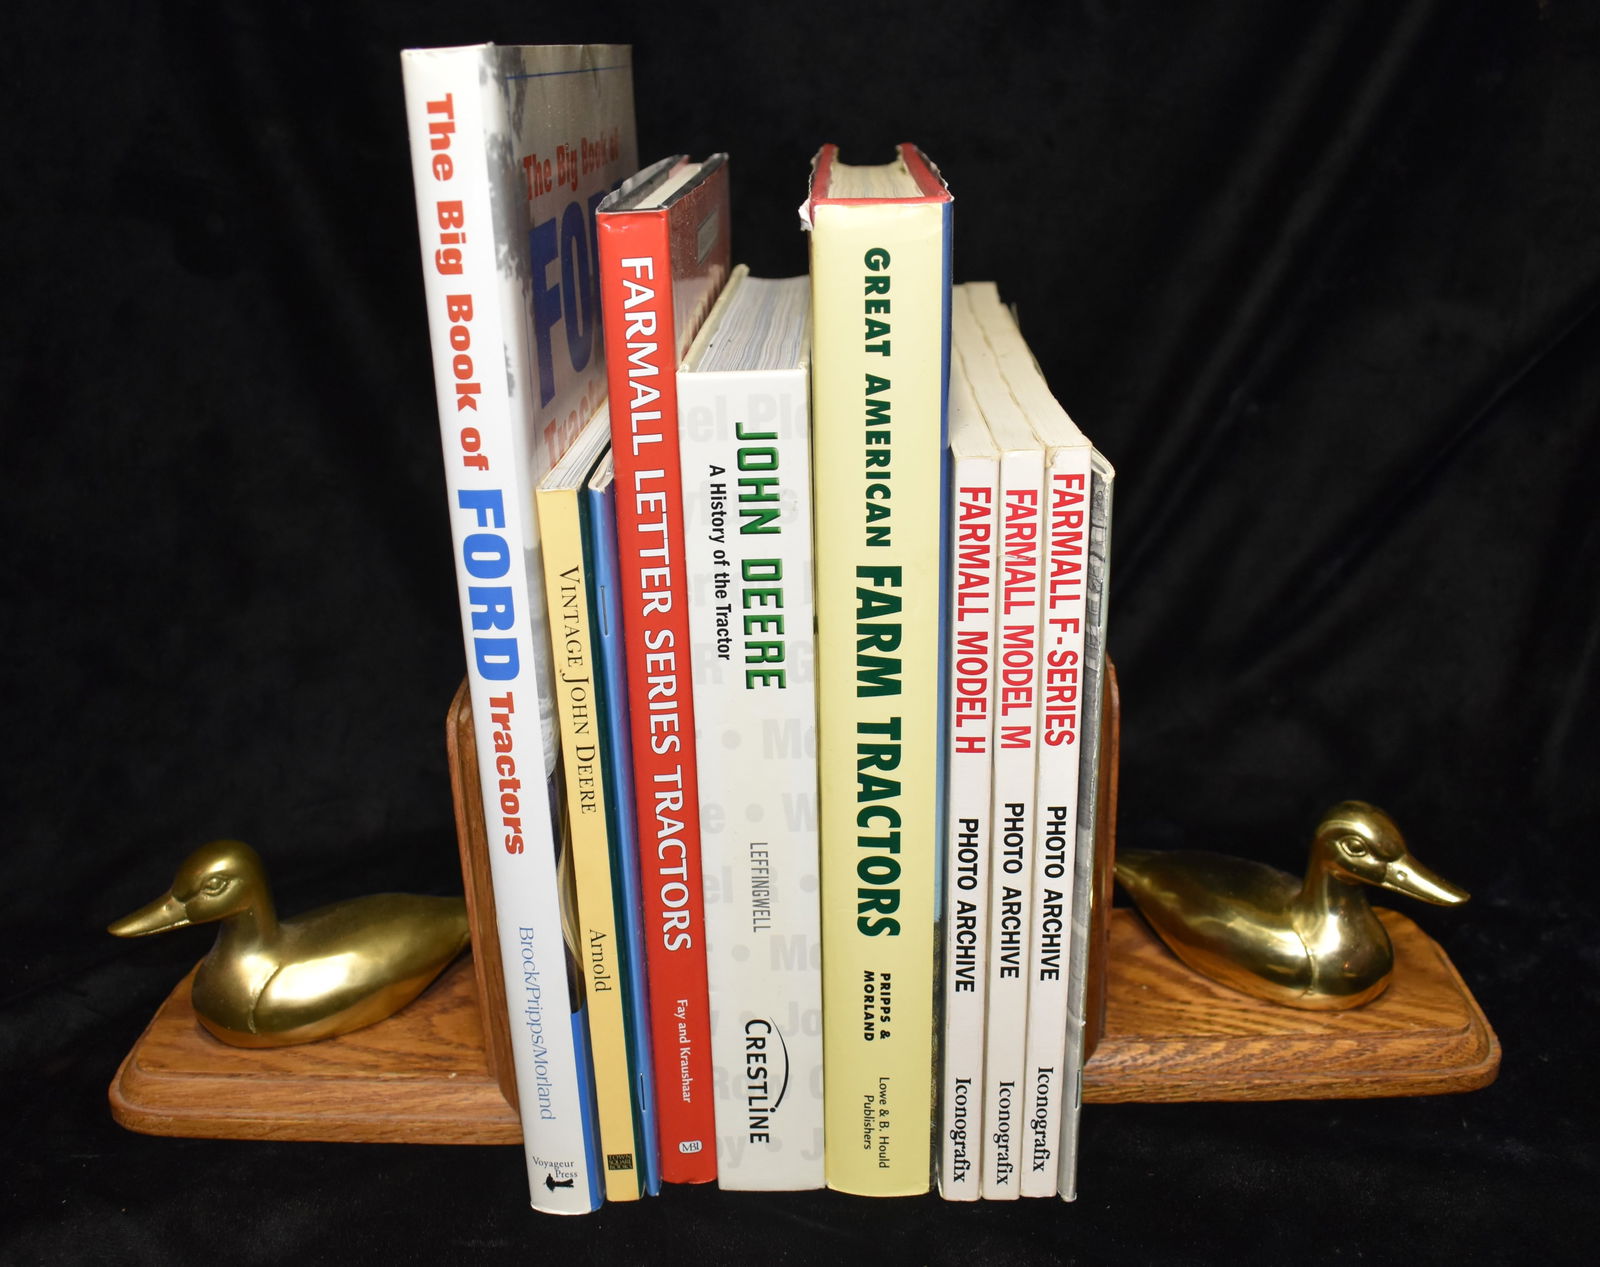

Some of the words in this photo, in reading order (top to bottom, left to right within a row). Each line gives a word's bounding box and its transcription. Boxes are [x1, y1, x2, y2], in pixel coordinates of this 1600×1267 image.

[426, 93, 456, 182] The
[523, 154, 552, 199] The
[556, 145, 579, 192] Big
[435, 200, 466, 275] Big
[864, 247, 891, 357] GREAT
[446, 294, 482, 412] Book
[621, 257, 662, 456] FARMALL
[460, 427, 489, 471] of
[709, 465, 726, 477] A
[736, 422, 781, 534] JOHN
[865, 374, 891, 546] AMERICAN
[634, 469, 673, 617] LETTER
[709, 483, 727, 543] History
[957, 487, 991, 621] FARMALL
[1004, 489, 1037, 615] FARMALL
[1050, 474, 1085, 609] FARMALL
[457, 489, 520, 681] FORD
[714, 550, 730, 566] of
[714, 573, 731, 598] the
[716, 604, 732, 660] Tractor
[741, 558, 786, 689] DEERE
[856, 566, 902, 697] FARM
[645, 629, 680, 755] SERIES
[956, 631, 988, 728] MODEL
[1002, 625, 1034, 716] MODEL
[1044, 618, 1079, 746] F-SERIES
[489, 691, 524, 855] Tractors
[955, 737, 986, 753] H
[1001, 726, 1031, 749] M
[653, 765, 692, 951] TRACTORS
[856, 717, 902, 937] TRACTORS
[956, 818, 979, 891] PHOTO
[1003, 803, 1024, 874] PHOTO
[1044, 806, 1067, 879] PHOTO
[750, 842, 771, 933] LEFFINGWELL
[589, 929, 612, 992] Arnold
[955, 900, 977, 992] ARCHIVE
[1000, 886, 1022, 979] ARCHIVE
[1040, 889, 1062, 980] ARCHIVE
[518, 926, 556, 1121] Brock/Pripps/Morland
[677, 999, 688, 1016] Fay
[678, 1020, 689, 1044] and
[864, 971, 875, 1041] MORLAND
[880, 973, 891, 1023] PRIPPS
[880, 1029, 890, 1039] &
[680, 1046, 691, 1103] Kraushaar
[879, 1077, 890, 1105] Lowe
[879, 1109, 889, 1117] &
[532, 1155, 575, 1170] Voyageur
[864, 1095, 874, 1149] Publishers
[879, 1122, 889, 1132] B.
[879, 1137, 889, 1168] Hould
[950, 1078, 972, 1183] Iconografix
[993, 1081, 1015, 1185] Iconografix
[1029, 1067, 1054, 1172] Iconografix
[555, 1169, 579, 1178] Press
